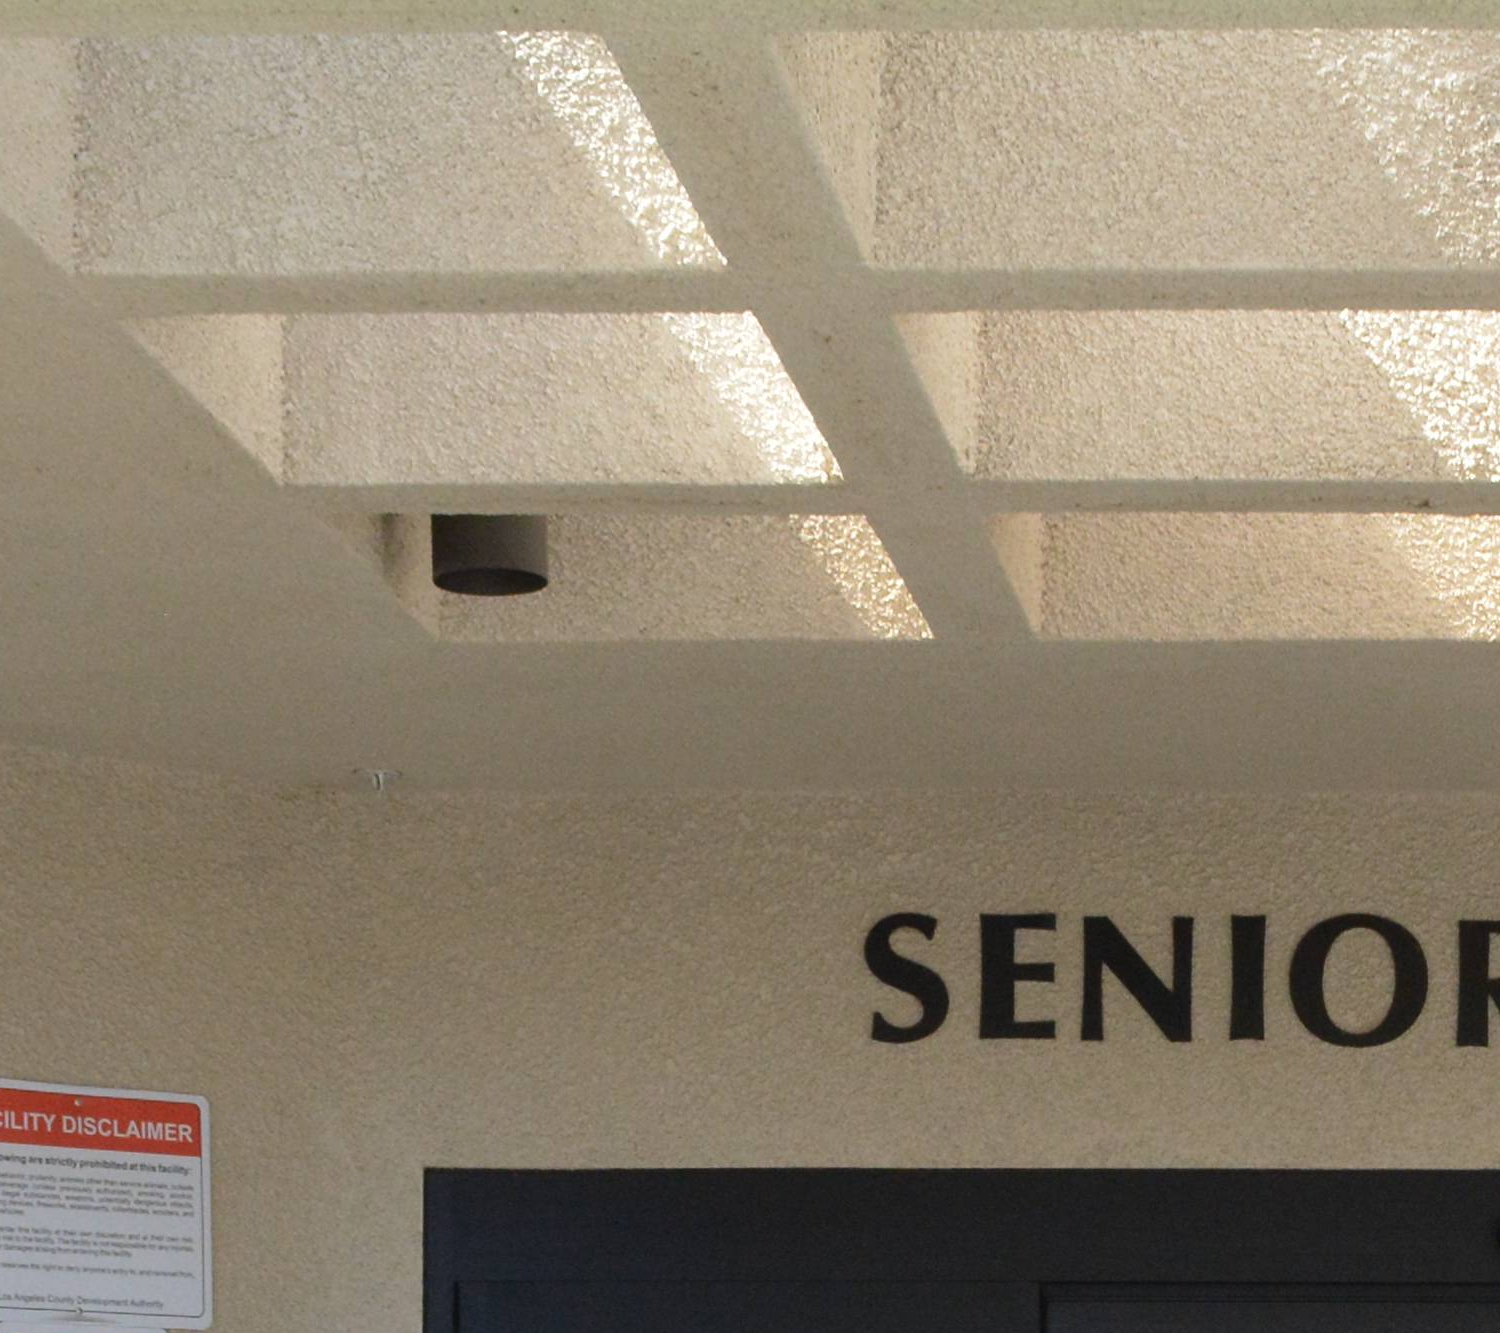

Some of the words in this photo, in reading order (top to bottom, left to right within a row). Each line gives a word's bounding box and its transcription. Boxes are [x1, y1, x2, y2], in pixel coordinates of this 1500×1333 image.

[62, 1115, 193, 1142] DISCLAIMER
[29, 1156, 43, 1164] are
[45, 1157, 77, 1168] strictly
[79, 1160, 127, 1171] prohibited
[130, 1161, 137, 1170] at
[140, 1162, 156, 1172] this
